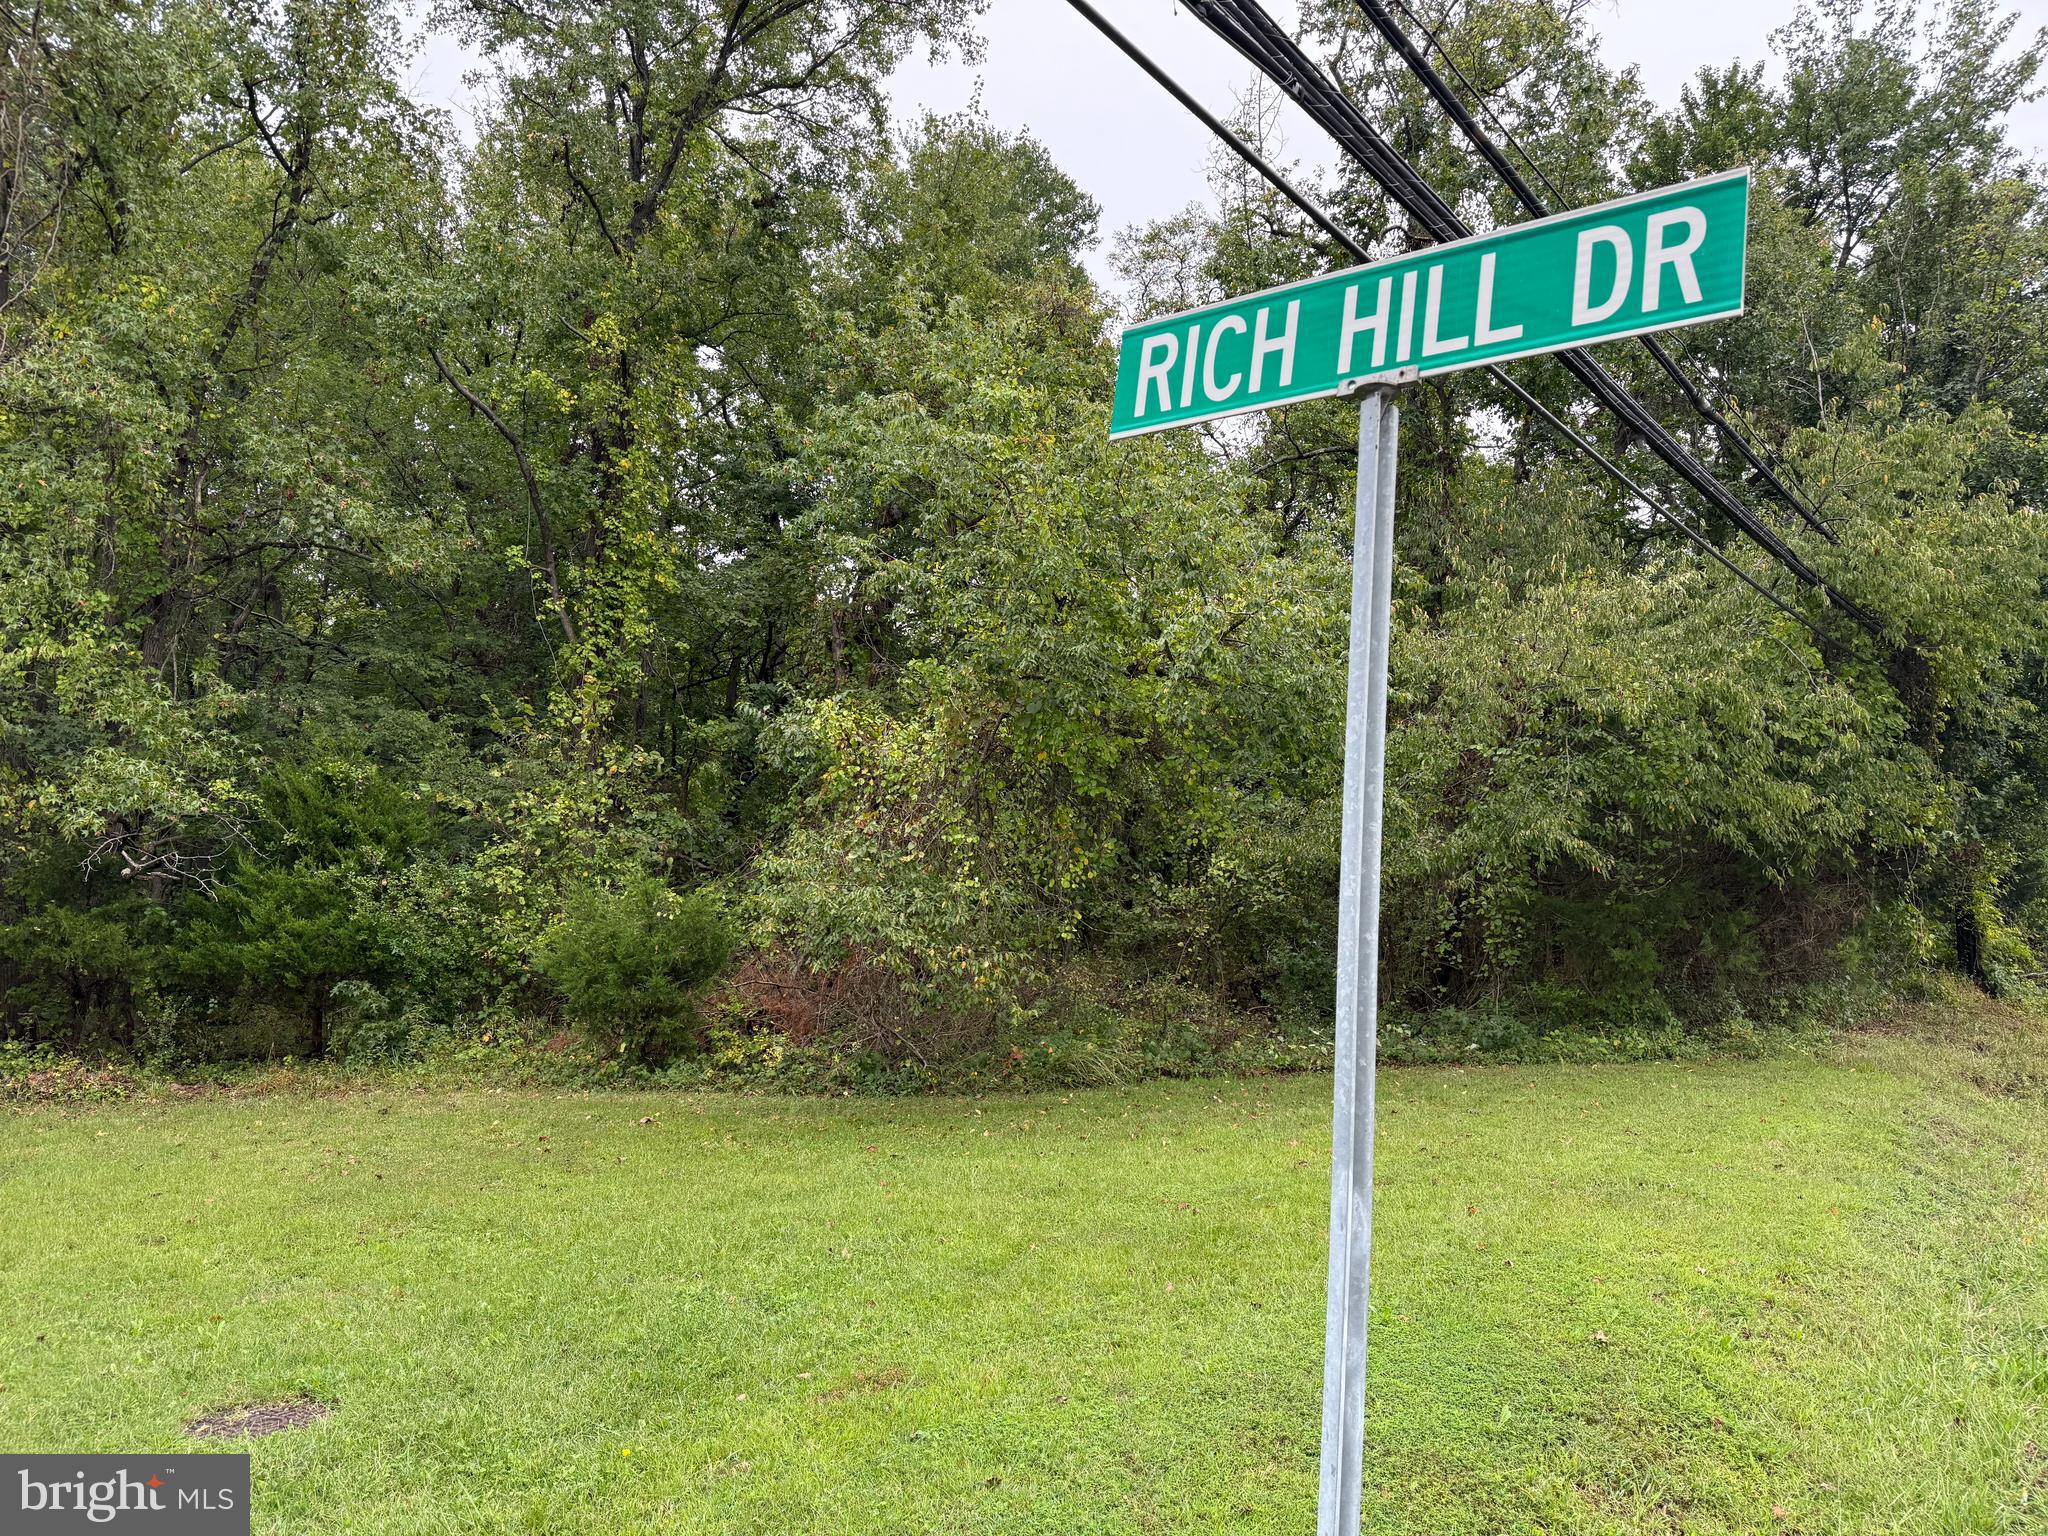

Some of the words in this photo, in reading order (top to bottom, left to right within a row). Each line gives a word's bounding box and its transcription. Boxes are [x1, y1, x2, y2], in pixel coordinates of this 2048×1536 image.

[1134, 299, 1301, 417] RICH
[1338, 252, 1524, 374] HILL
[1571, 205, 1707, 326] DR
